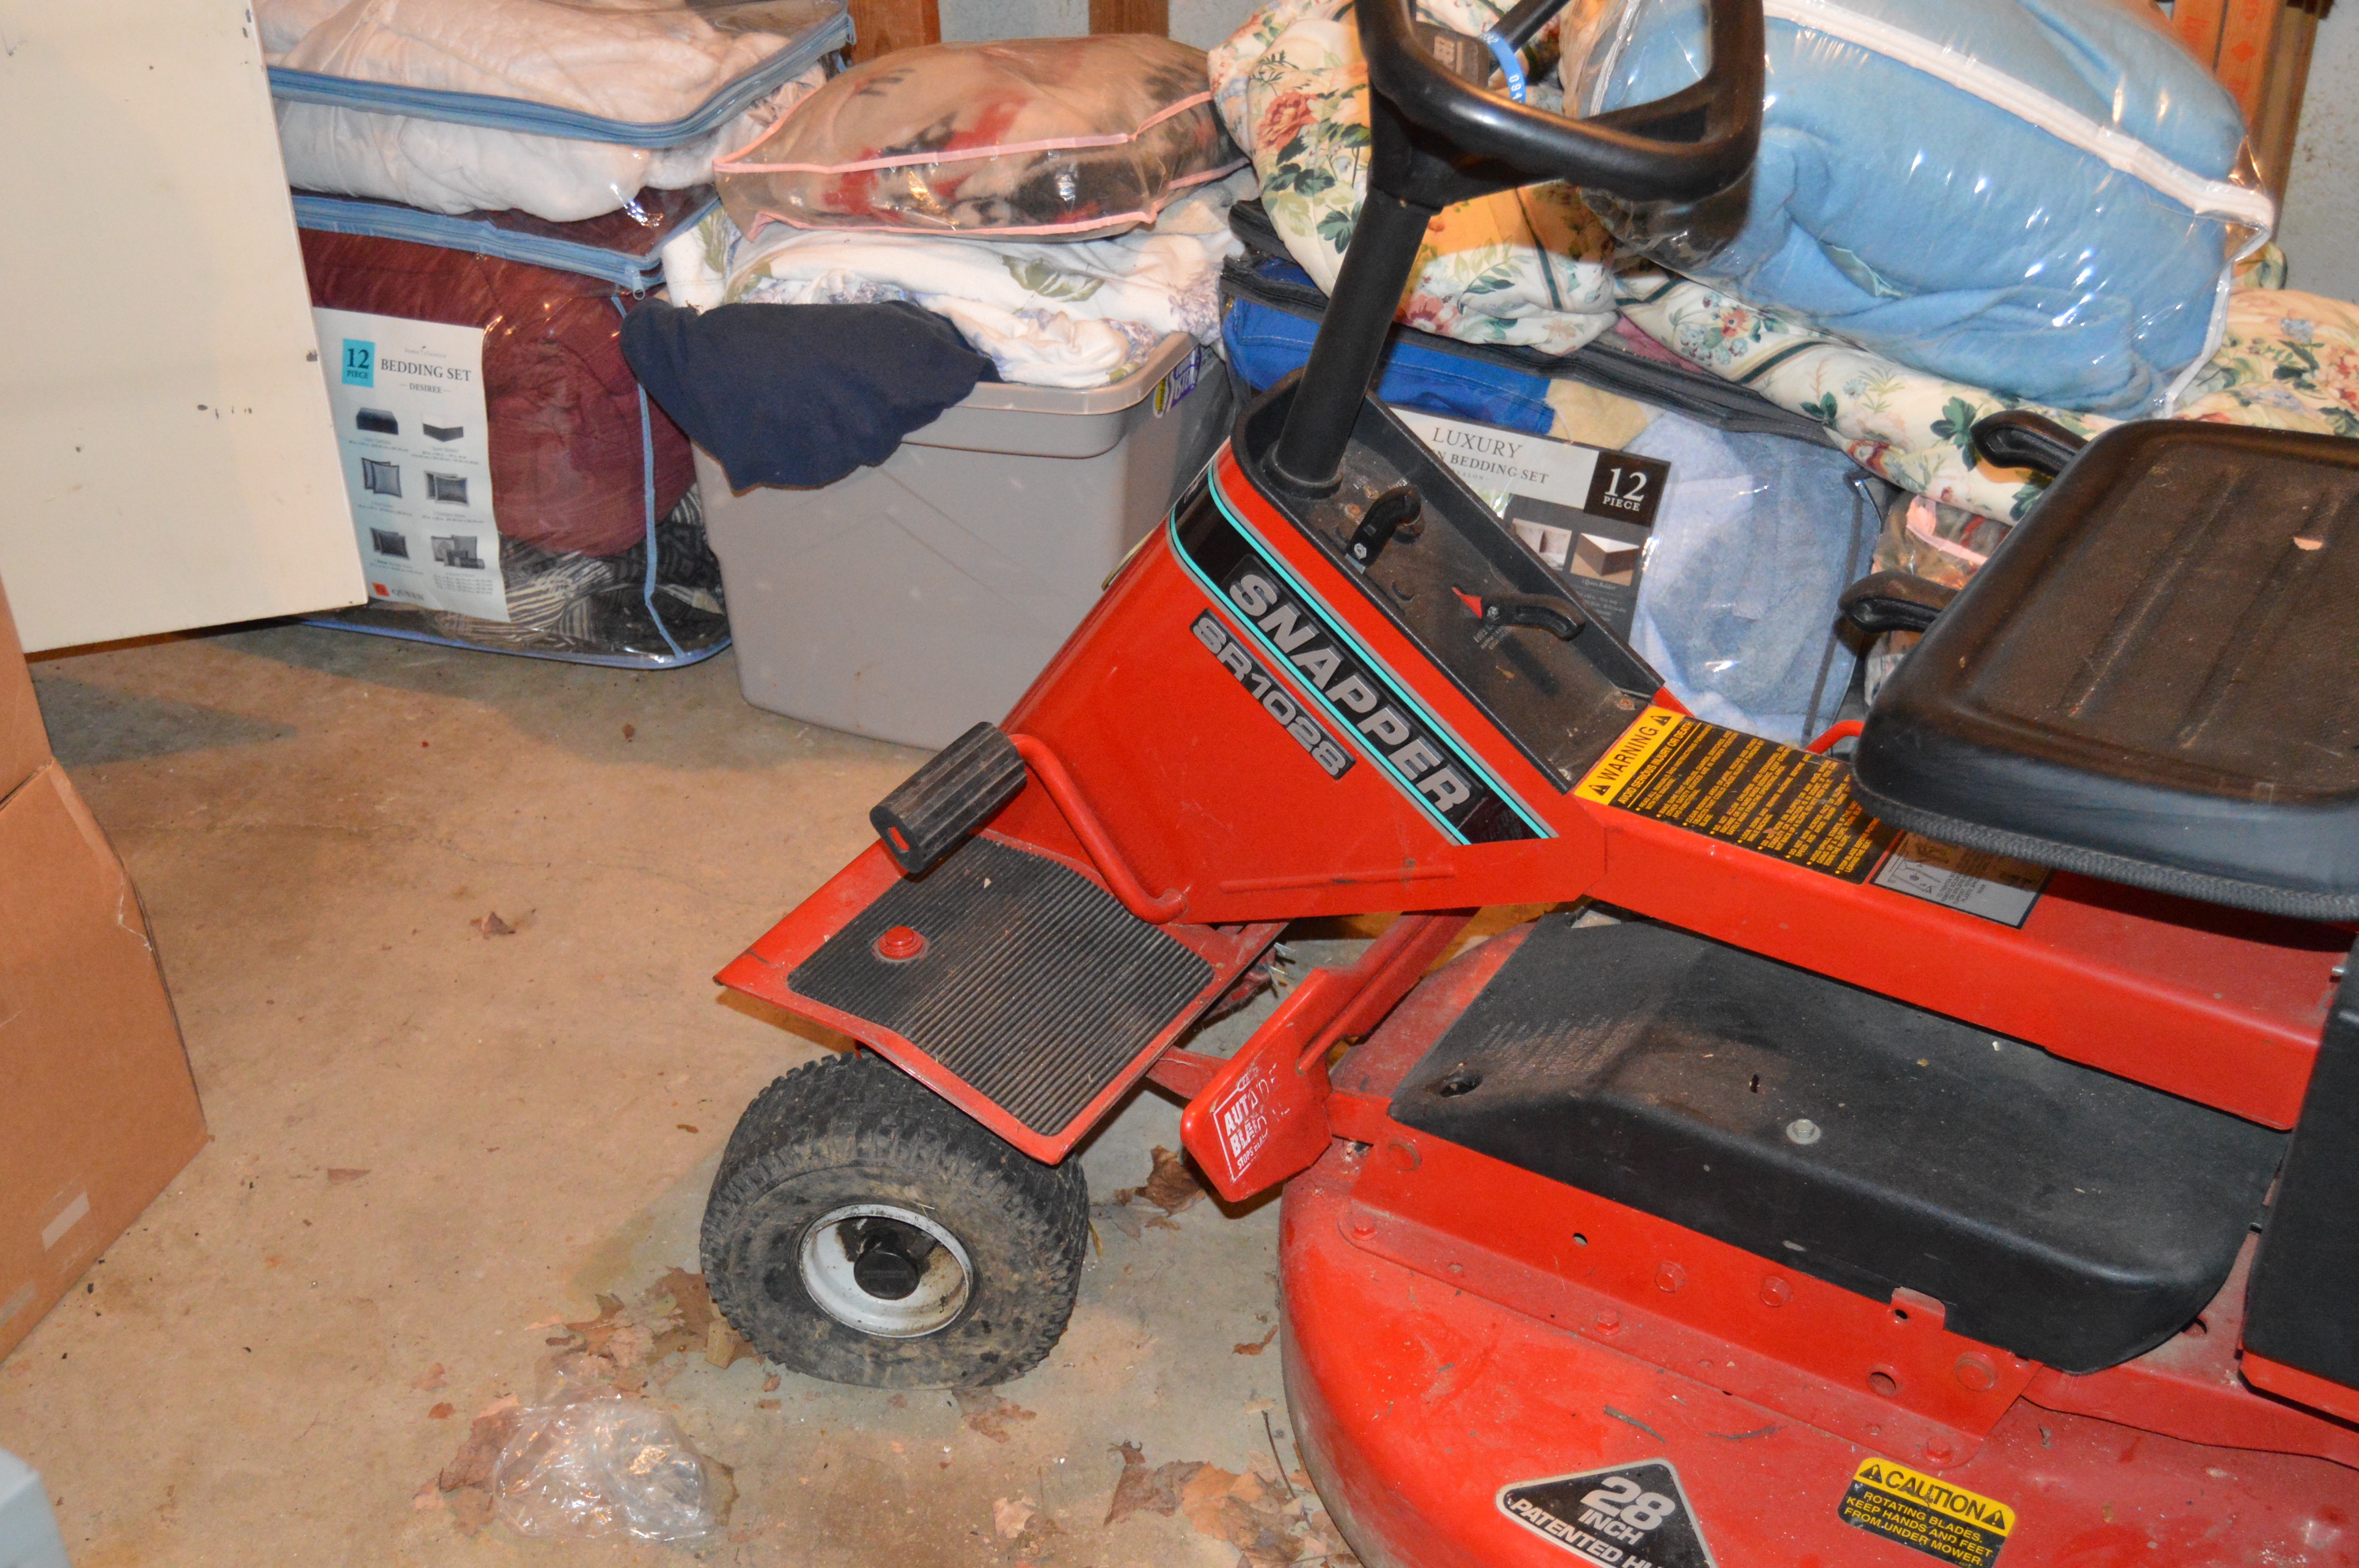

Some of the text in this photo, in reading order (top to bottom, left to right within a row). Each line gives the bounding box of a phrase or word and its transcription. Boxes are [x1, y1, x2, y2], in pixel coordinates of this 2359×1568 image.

[347, 348, 370, 369] 12
[347, 370, 369, 379] PIECE
[381, 359, 472, 382] BEDDING SET
[409, 383, 442, 394] DESIREE
[1432, 427, 1522, 459] LUXURY
[1450, 454, 1517, 477] BEDDING
[1520, 470, 1550, 485] SET
[1605, 468, 1647, 502] 12
[1602, 496, 1641, 512] PIECE
[1193, 617, 1346, 777] SR1028
[1230, 574, 1470, 812] SNAPPER
[1598, 725, 1658, 782] WARNING
[1616, 720, 1695, 804] AVOID SERIOUS INJURY OR DEATH
[1237, 1147, 1254, 1170] STOPS
[1580, 1476, 1676, 1530] 28
[1863, 1491, 1982, 1543] ROTATING BLADES.
[1885, 1471, 1986, 1521] CAUTION
[1510, 1498, 1623, 1562] PATENTED
[1578, 1509, 1644, 1545] INCH
[1844, 1507, 1983, 1566] FROM UNDER MOWER.
[1846, 1496, 1993, 1557] KEEP HANDS AND FEET
